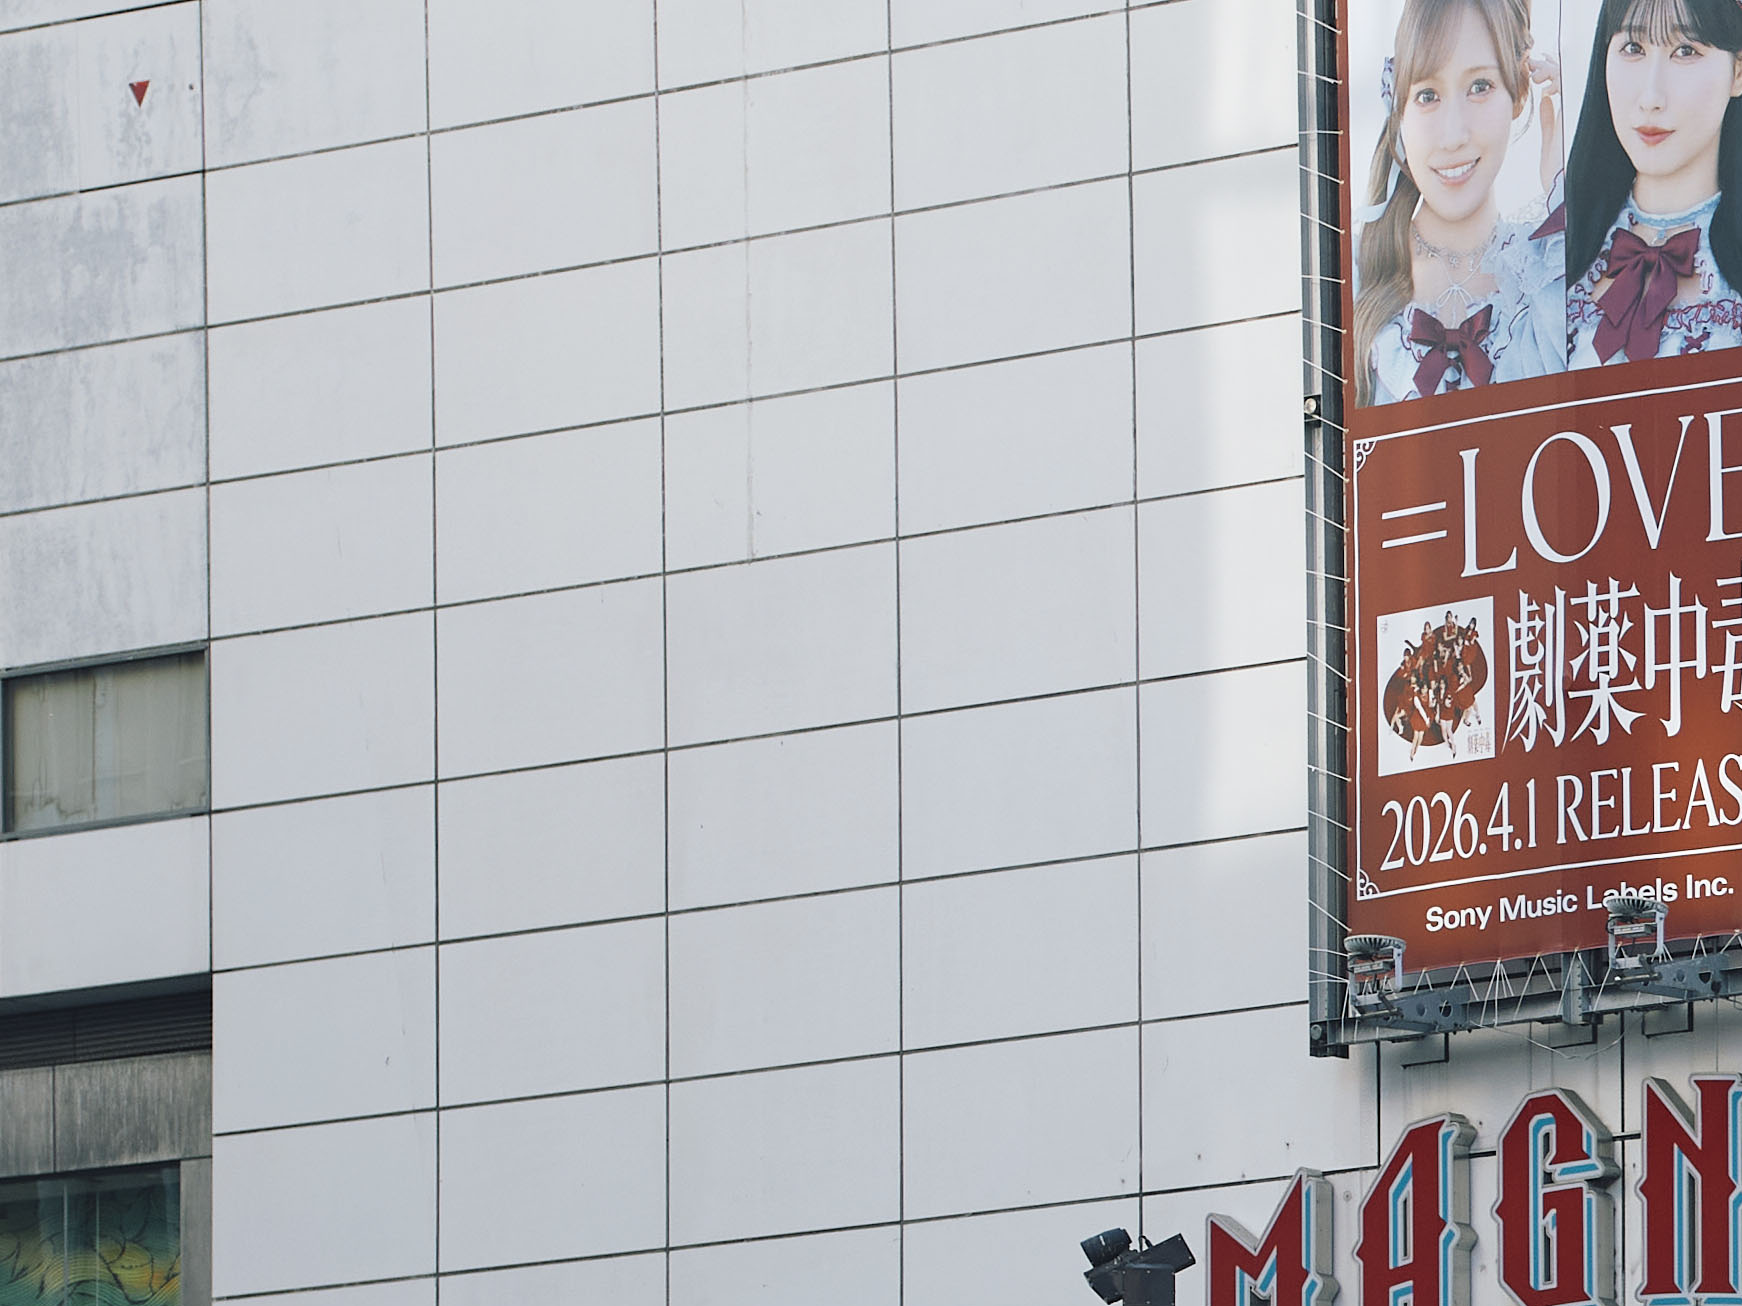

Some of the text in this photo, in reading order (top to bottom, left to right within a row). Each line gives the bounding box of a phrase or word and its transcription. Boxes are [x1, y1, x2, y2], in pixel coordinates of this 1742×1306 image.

[1380, 779, 1541, 873] 2026.4.1
[1425, 899, 1491, 934] Sony
[1498, 890, 1579, 926] Music
[1685, 873, 1735, 905] Inc.
